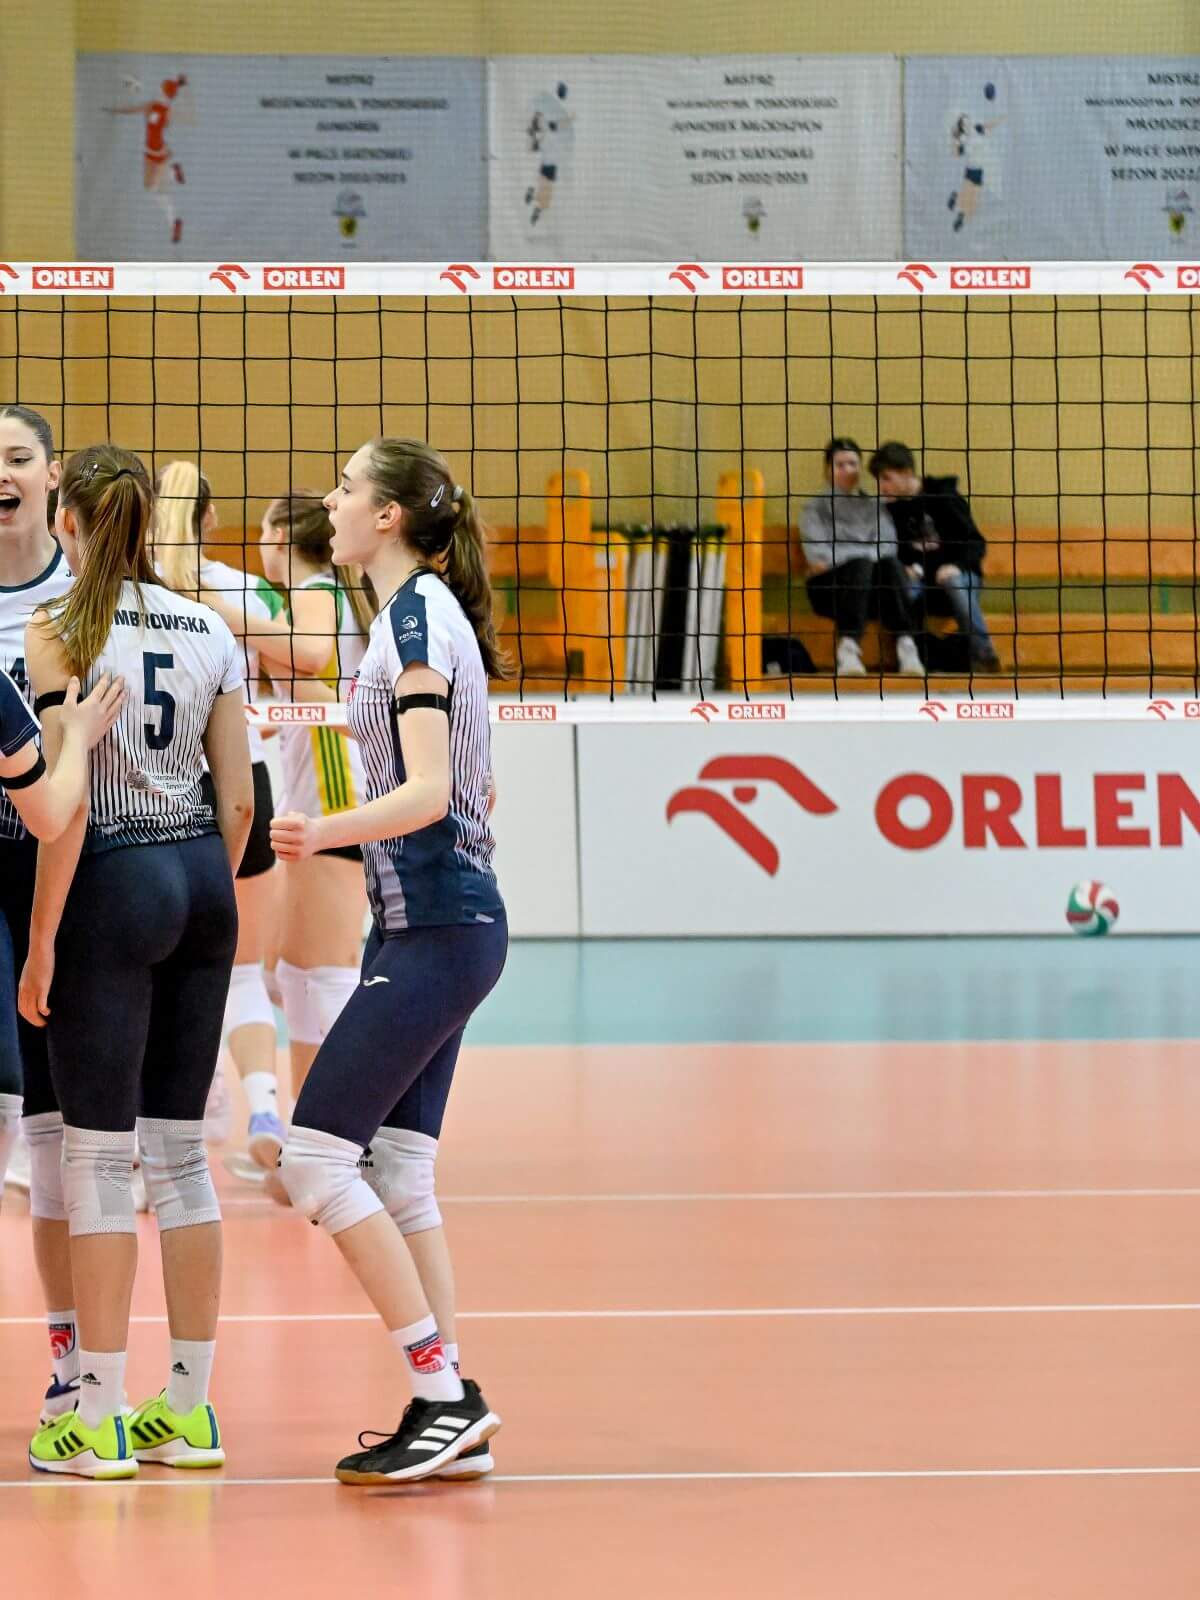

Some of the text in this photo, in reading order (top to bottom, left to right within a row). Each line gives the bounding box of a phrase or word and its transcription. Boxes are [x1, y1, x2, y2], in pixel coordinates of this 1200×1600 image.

[36, 270, 110, 286] ORLEN
[267, 270, 340, 287] ORLEN
[497, 270, 570, 287] ORLEN
[726, 270, 798, 286] ORLEN
[954, 270, 1026, 286] ORLEN
[113, 609, 210, 635] MBROWSKA
[143, 651, 175, 750] 5
[271, 707, 323, 720] ORLEN
[501, 706, 553, 719] ORLEN
[731, 705, 781, 718] ORLEN
[960, 704, 1011, 717] ORLEN
